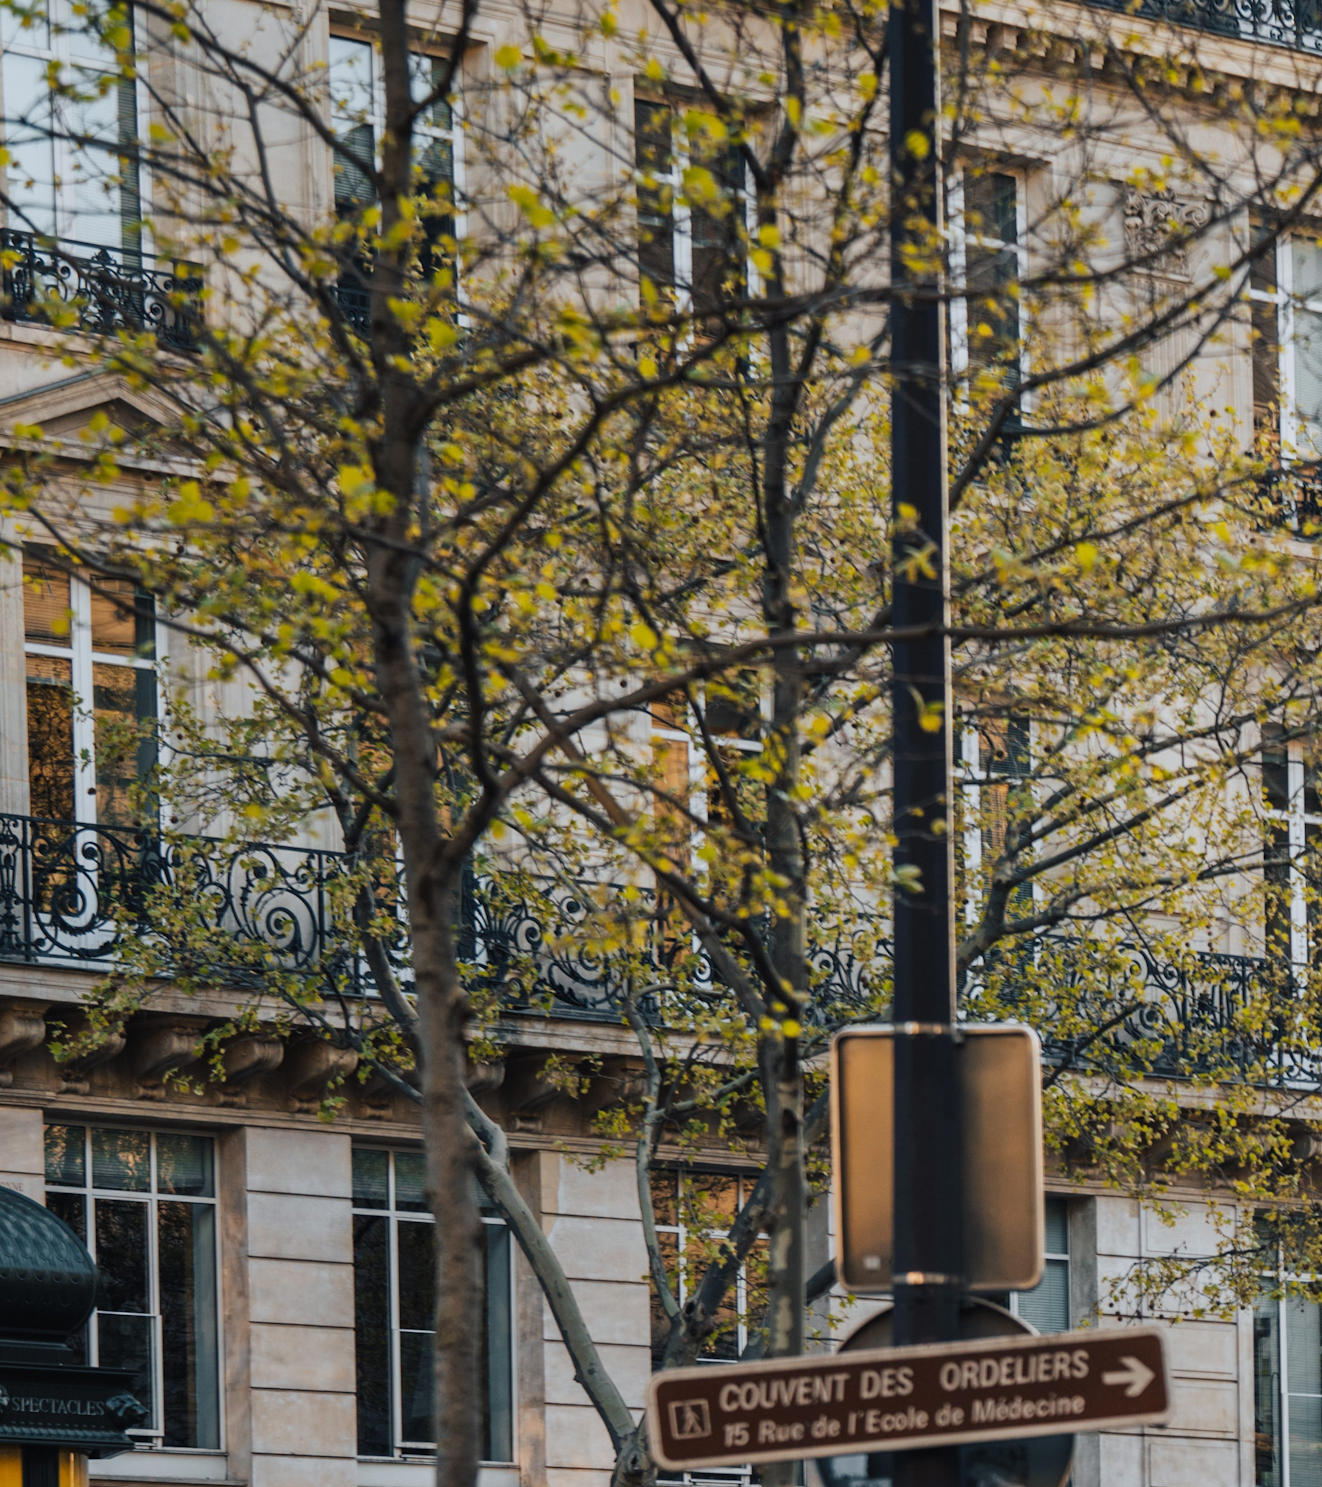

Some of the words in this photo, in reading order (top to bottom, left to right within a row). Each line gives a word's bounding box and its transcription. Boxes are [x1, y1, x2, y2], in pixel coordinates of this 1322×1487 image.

[10, 1397, 105, 1416] SPECTACLES
[719, 1372, 851, 1412] COUVENT
[859, 1366, 914, 1400] DES
[723, 1422, 750, 1447] 15
[758, 1420, 804, 1444] Rue
[810, 1414, 841, 1439] de
[934, 1402, 965, 1426] de
[971, 1394, 1086, 1424] Médecine
